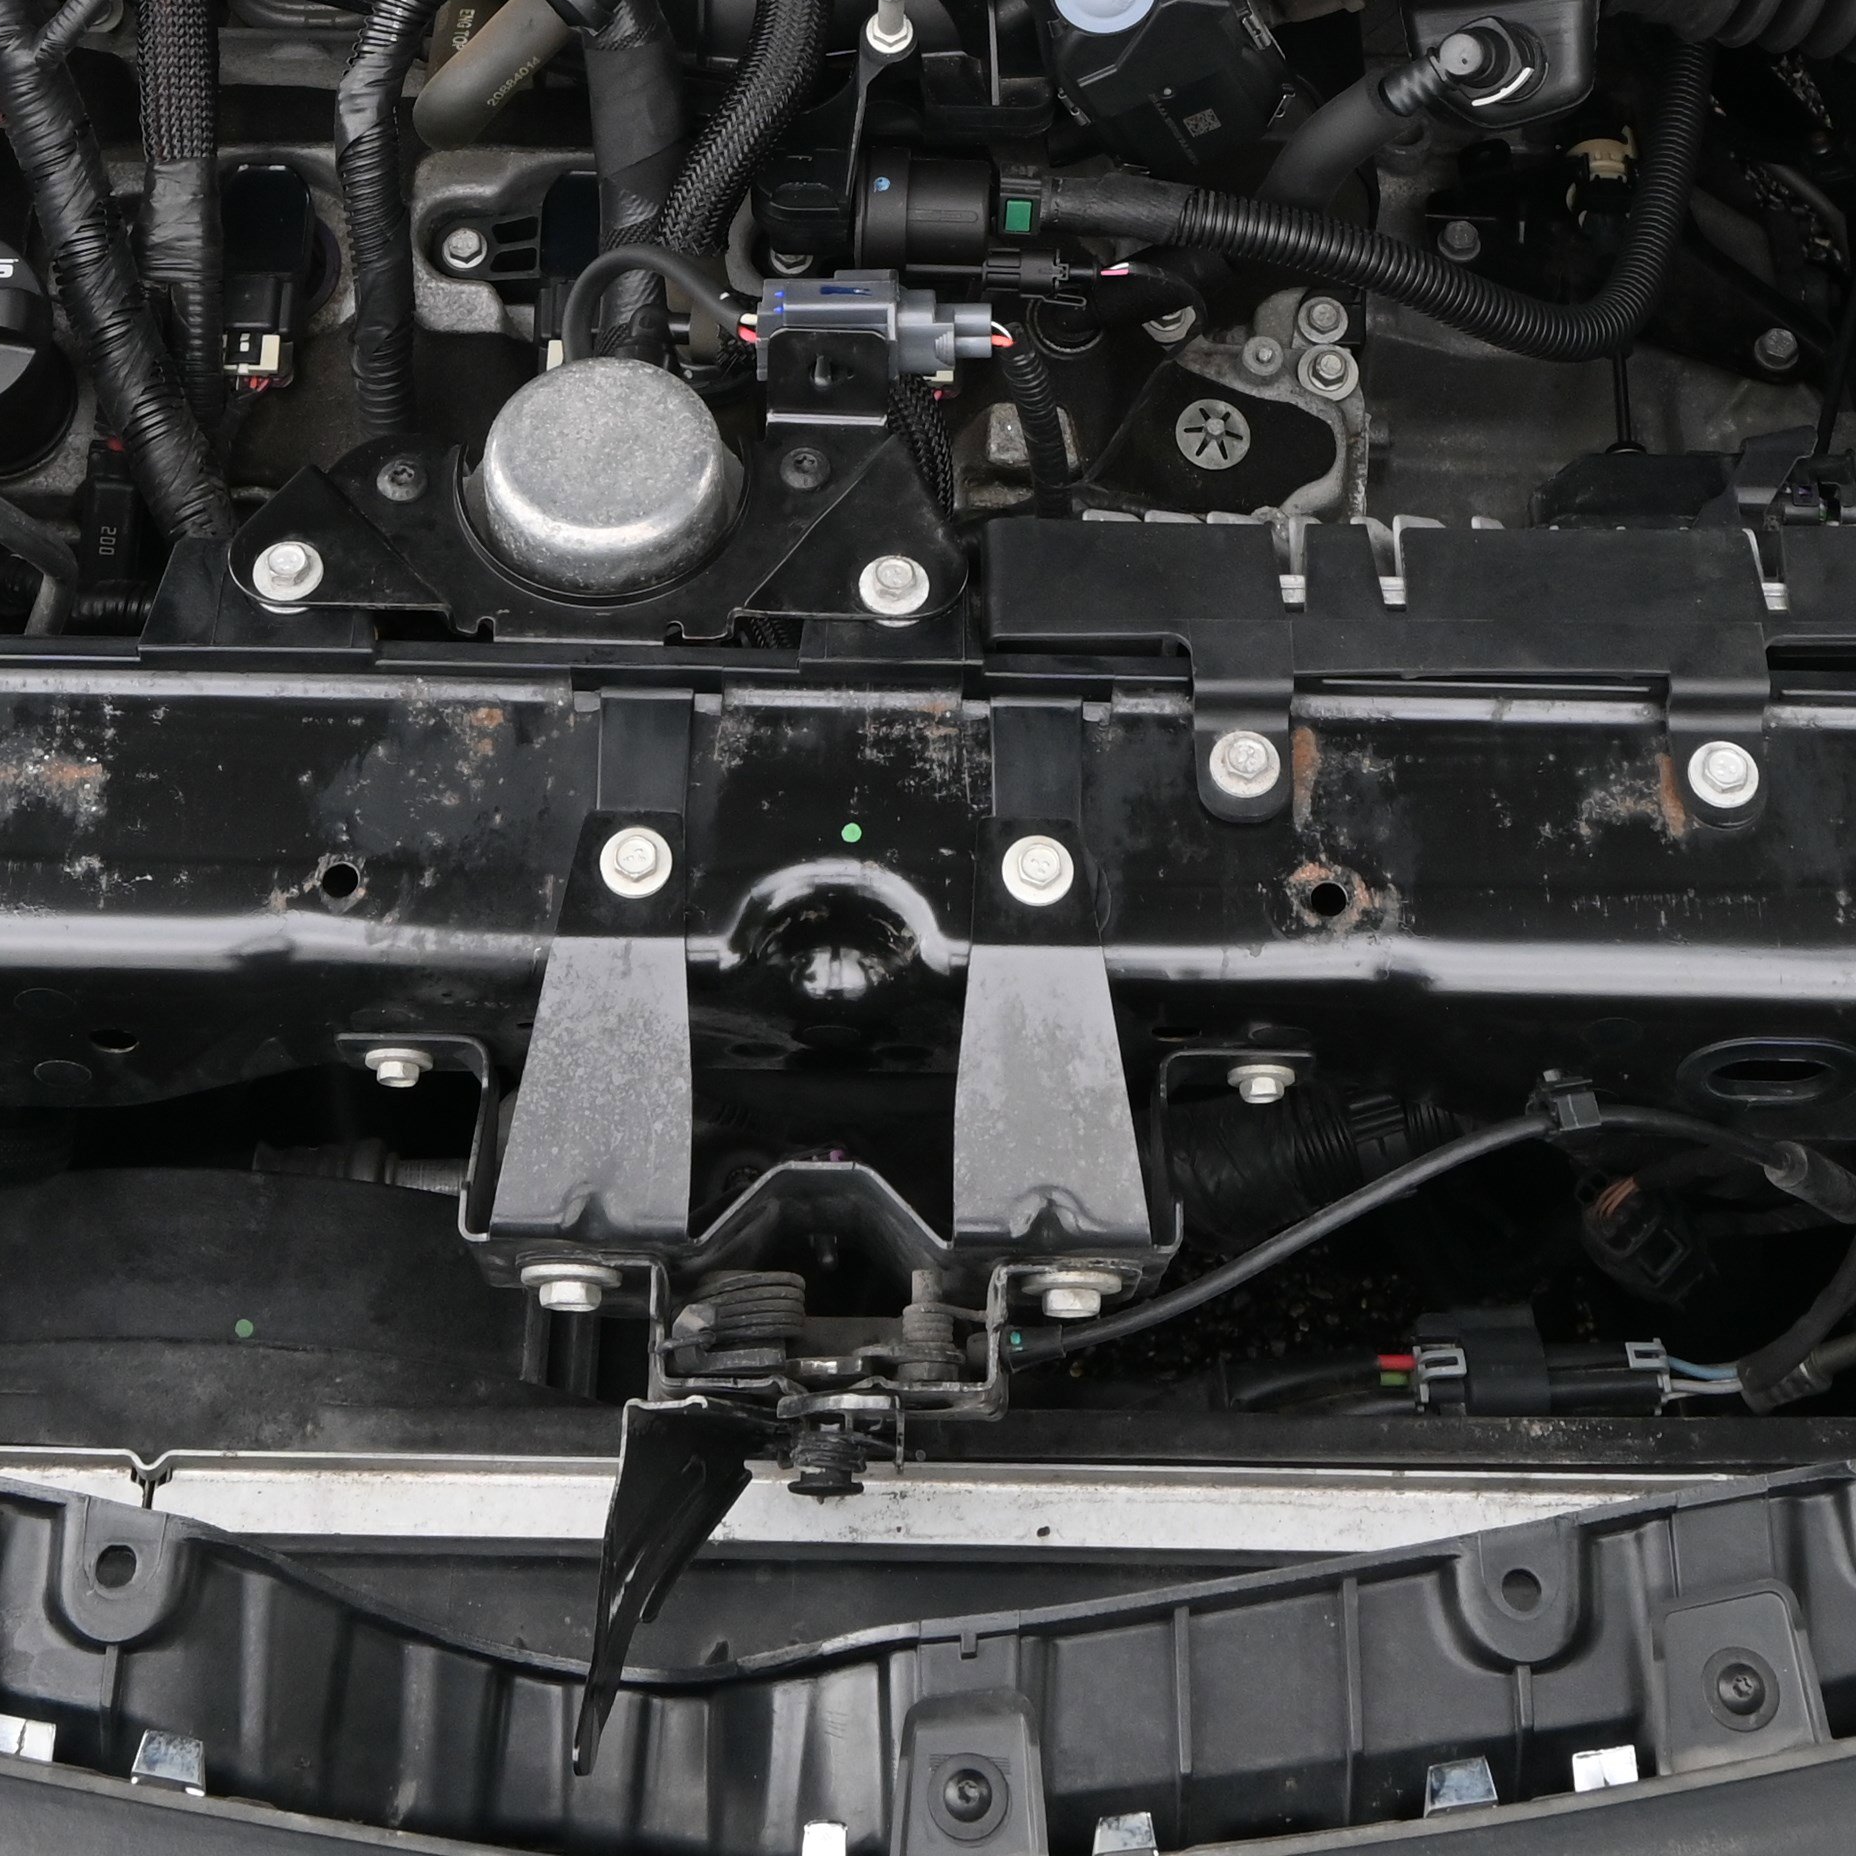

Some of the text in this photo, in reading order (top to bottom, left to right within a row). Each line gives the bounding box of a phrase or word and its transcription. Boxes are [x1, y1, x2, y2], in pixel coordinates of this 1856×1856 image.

[457, 8, 476, 28] ENG
[486, 55, 541, 108] 20884014
[98, 525, 117, 556] 200
